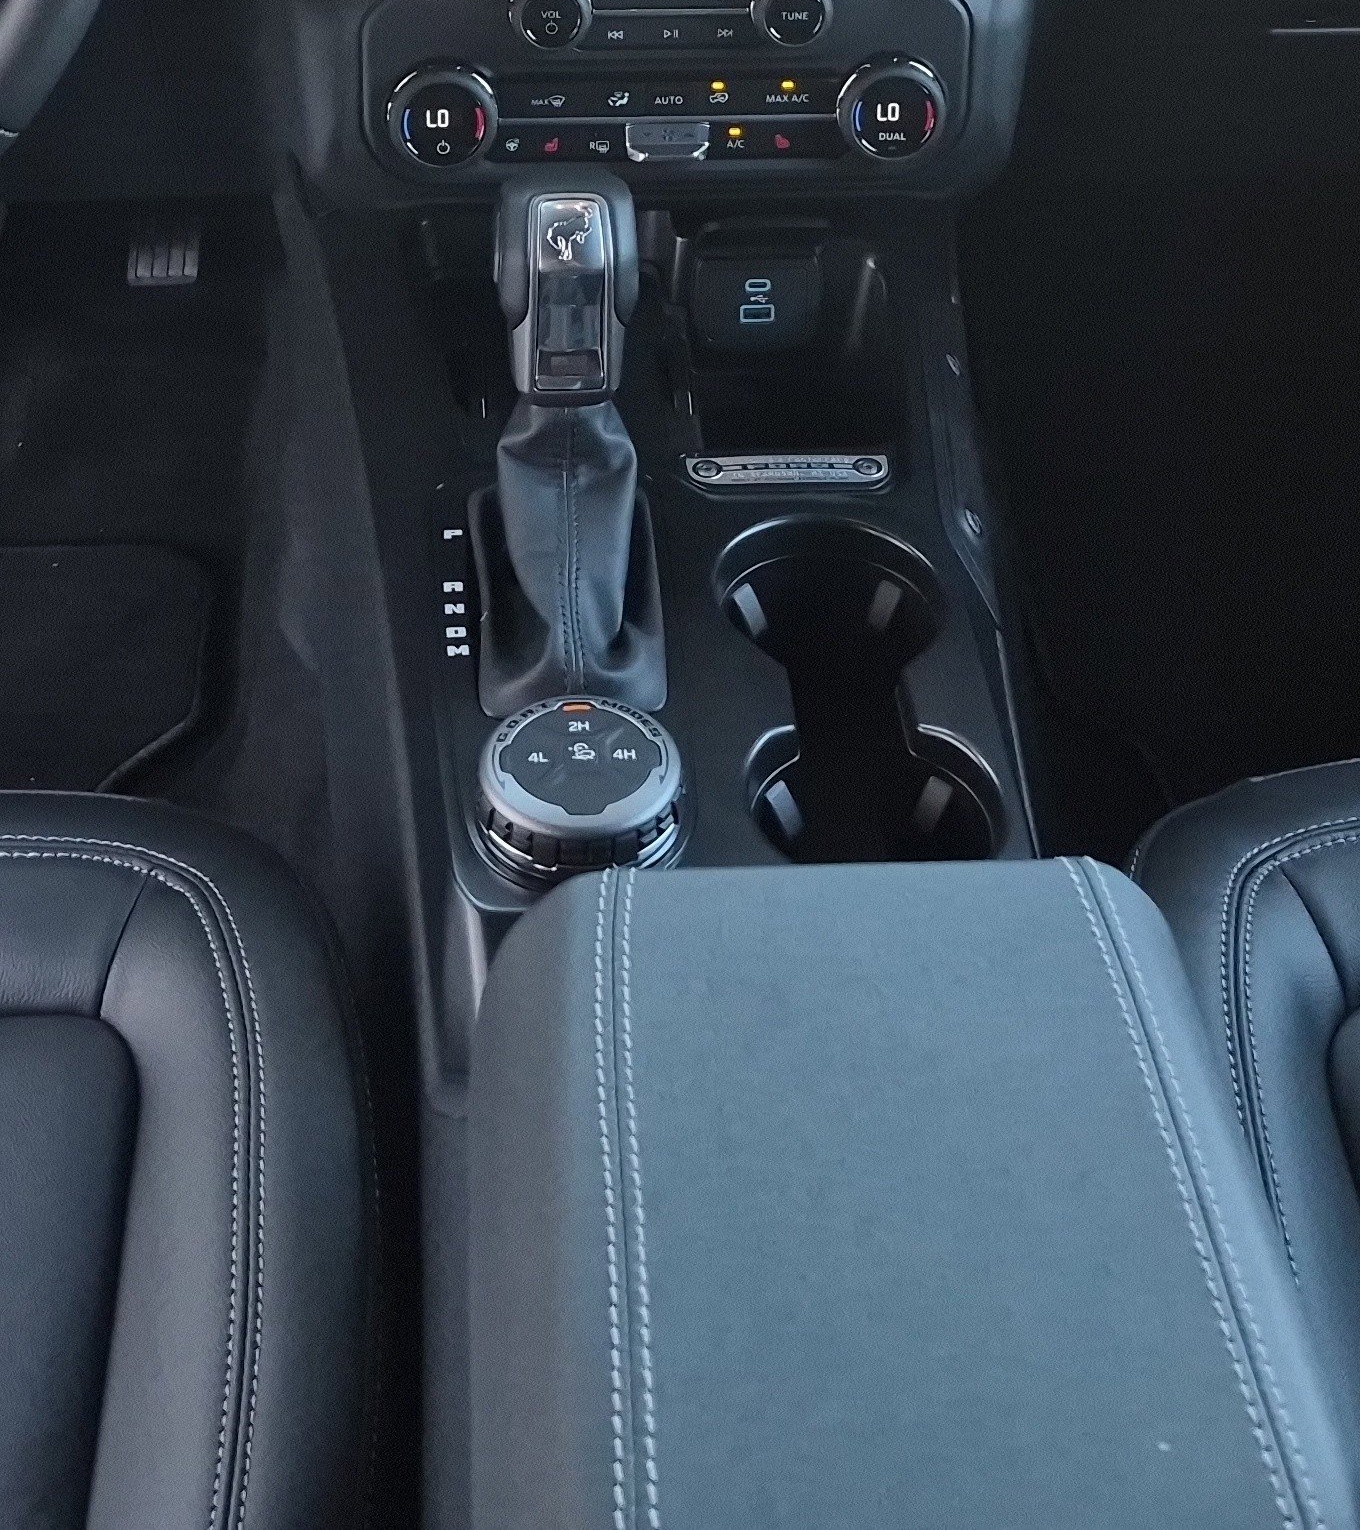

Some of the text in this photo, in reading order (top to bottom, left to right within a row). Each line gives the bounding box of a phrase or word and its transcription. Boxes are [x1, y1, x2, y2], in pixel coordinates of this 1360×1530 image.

[540, 10, 562, 19] VOL
[781, 11, 809, 21] TUNE
[654, 95, 684, 105] AUTO
[766, 94, 810, 103] MAX A/C
[876, 102, 900, 122] LO
[425, 109, 449, 128] LO
[878, 132, 907, 141] DUAL
[726, 140, 745, 148] A/C
[601, 699, 662, 738] MODES
[568, 721, 590, 732] 2H
[527, 752, 550, 763] 4L
[612, 749, 637, 761] 4H
